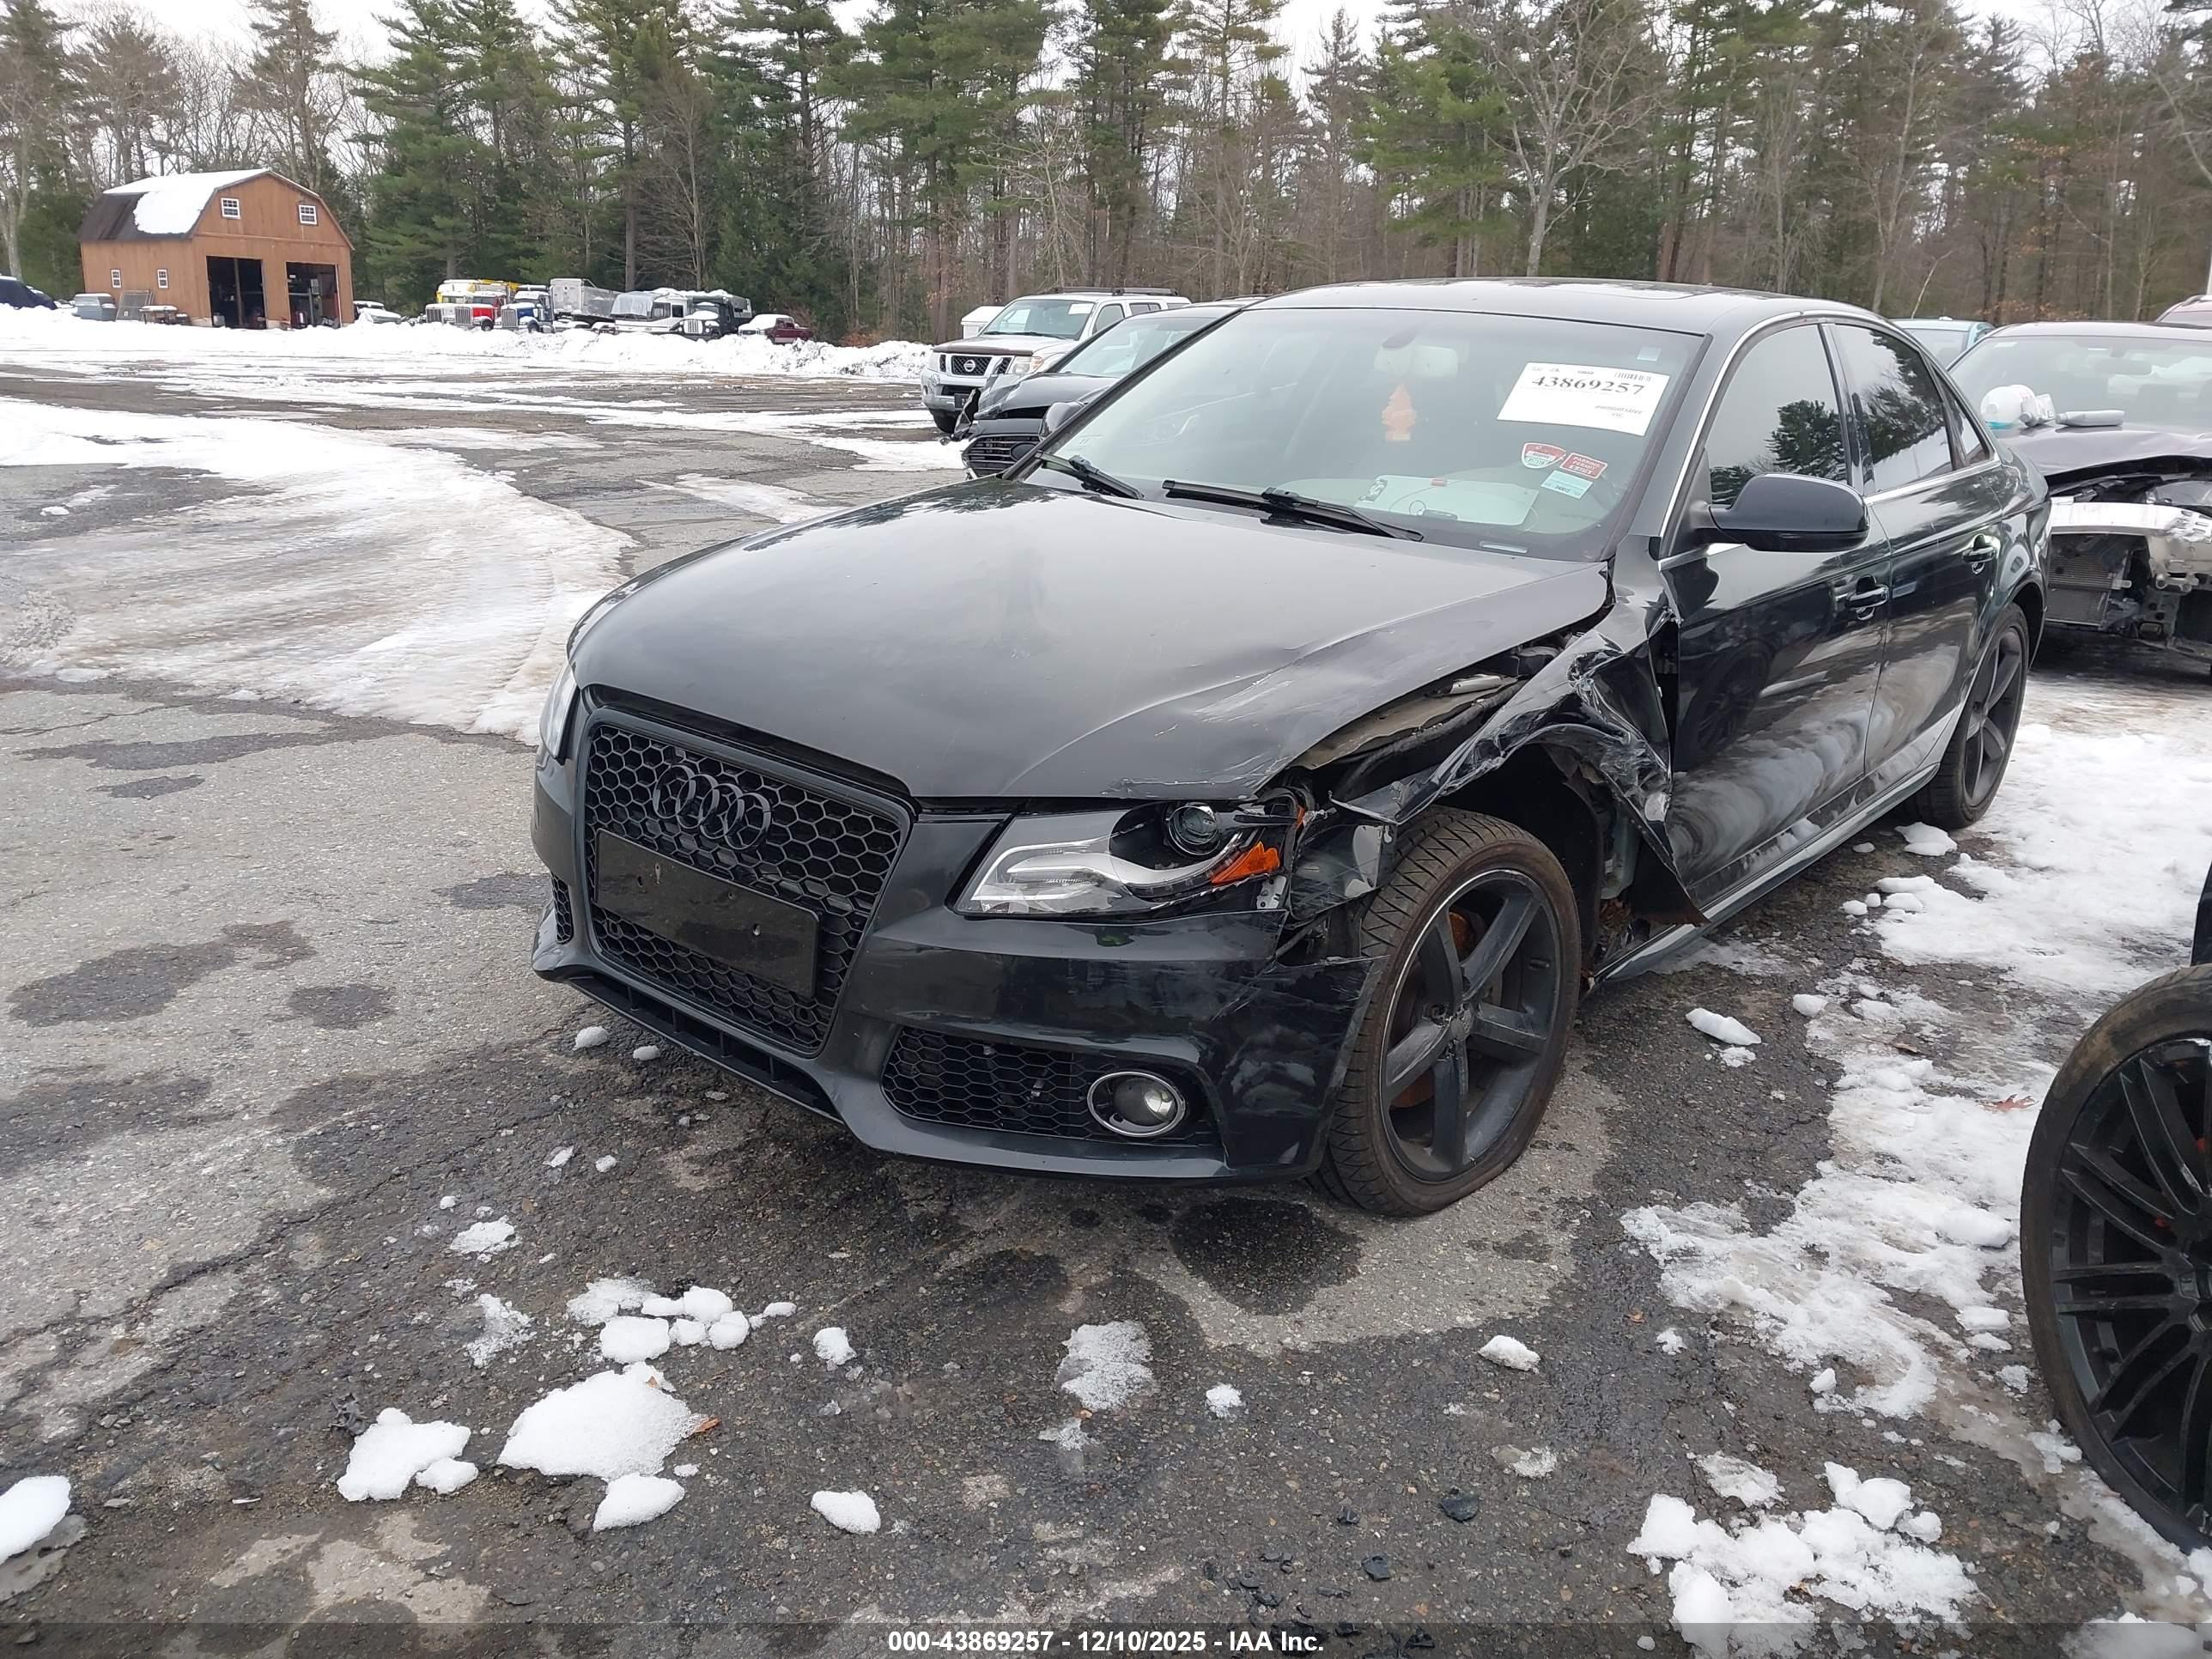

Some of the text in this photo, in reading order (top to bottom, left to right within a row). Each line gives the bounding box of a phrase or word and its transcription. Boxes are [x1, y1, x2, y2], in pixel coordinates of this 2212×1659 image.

[1532, 375, 1645, 395] 43869257
[1572, 456, 1601, 468] PARKING
[1572, 460, 1595, 471] PERMIT
